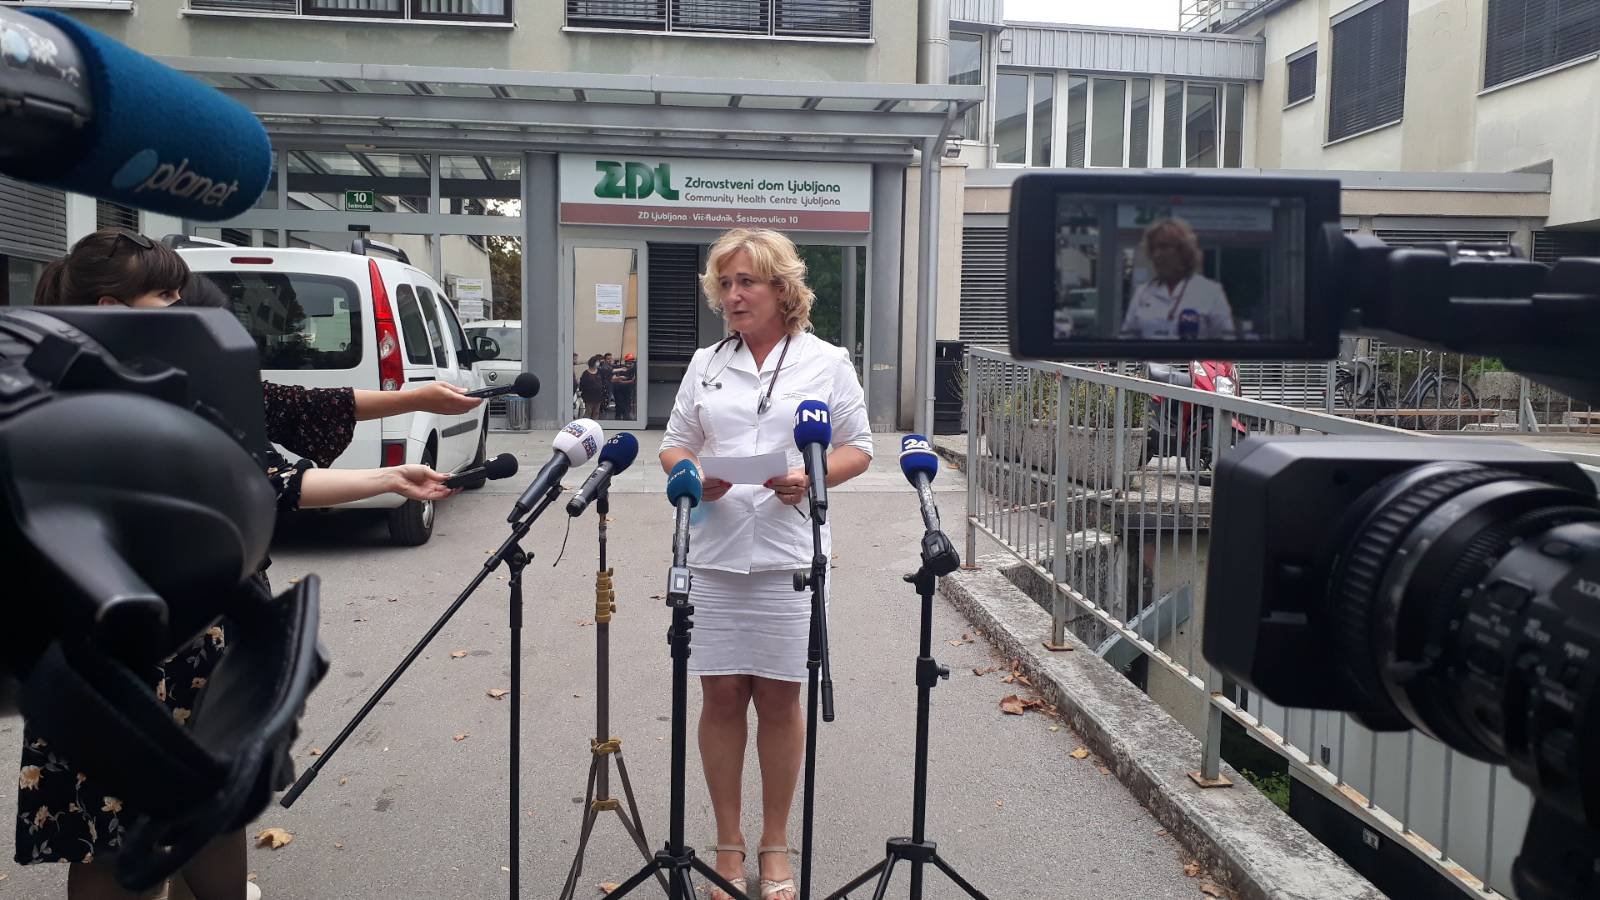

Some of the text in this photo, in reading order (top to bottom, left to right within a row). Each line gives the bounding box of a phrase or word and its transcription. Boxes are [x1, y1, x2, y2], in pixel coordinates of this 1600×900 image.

[136, 158, 238, 206] planet
[594, 160, 680, 200] ZDL
[685, 177, 841, 195] Zdravstveni dom Ljubljana
[353, 192, 367, 203] 10
[684, 192, 841, 207] Community Health Centre Ljubljana
[638, 211, 650, 219] ZD
[651, 211, 688, 221] Ljubljana
[768, 216, 787, 224] ulica
[789, 216, 799, 224] 10
[802, 408, 828, 424] N1
